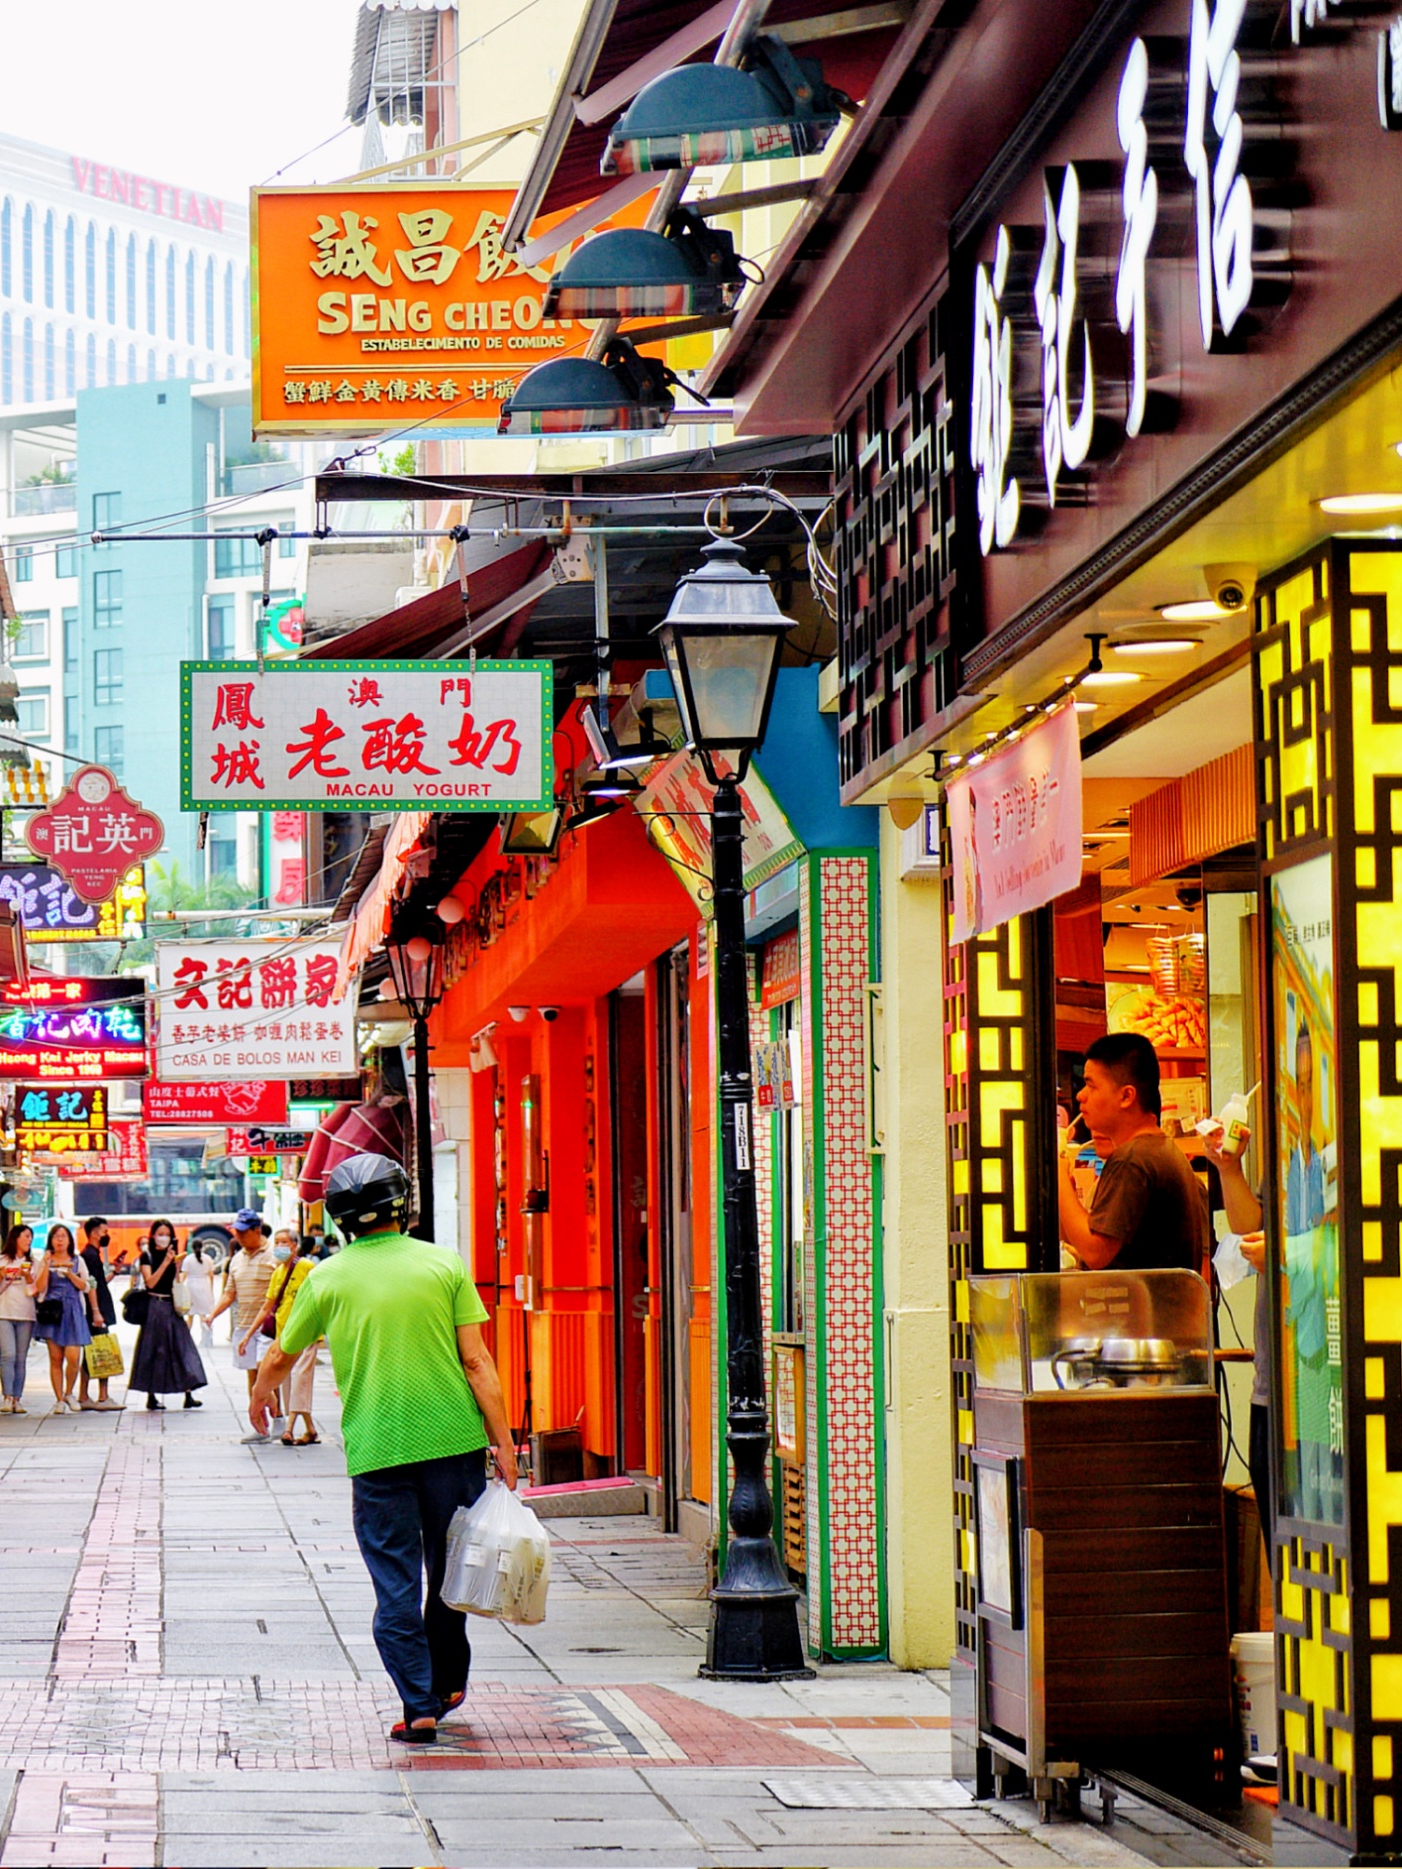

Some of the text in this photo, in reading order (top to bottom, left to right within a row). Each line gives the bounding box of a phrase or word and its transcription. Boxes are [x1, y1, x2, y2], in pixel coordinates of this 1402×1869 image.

[72, 155, 225, 234] VENETIAN
[317, 292, 431, 335] SENG
[361, 335, 565, 352] ESTABELECIMENTO DE COMIDAS
[347, 676, 473, 708] 澳門
[210, 681, 266, 790] 鳳城
[285, 707, 522, 780] 老酸奶
[326, 783, 492, 797] MACAU YOGURT
[173, 954, 341, 1010] 文記餅家
[39, 1064, 74, 1076] Since
[65, 1051, 101, 1065] Jerky
[104, 1051, 143, 1063] Macau
[173, 1050, 342, 1067] CASA DE BOLOS MAN KEI
[20, 1090, 88, 1121] 鉅記
[150, 1100, 179, 1108] TAIPA
